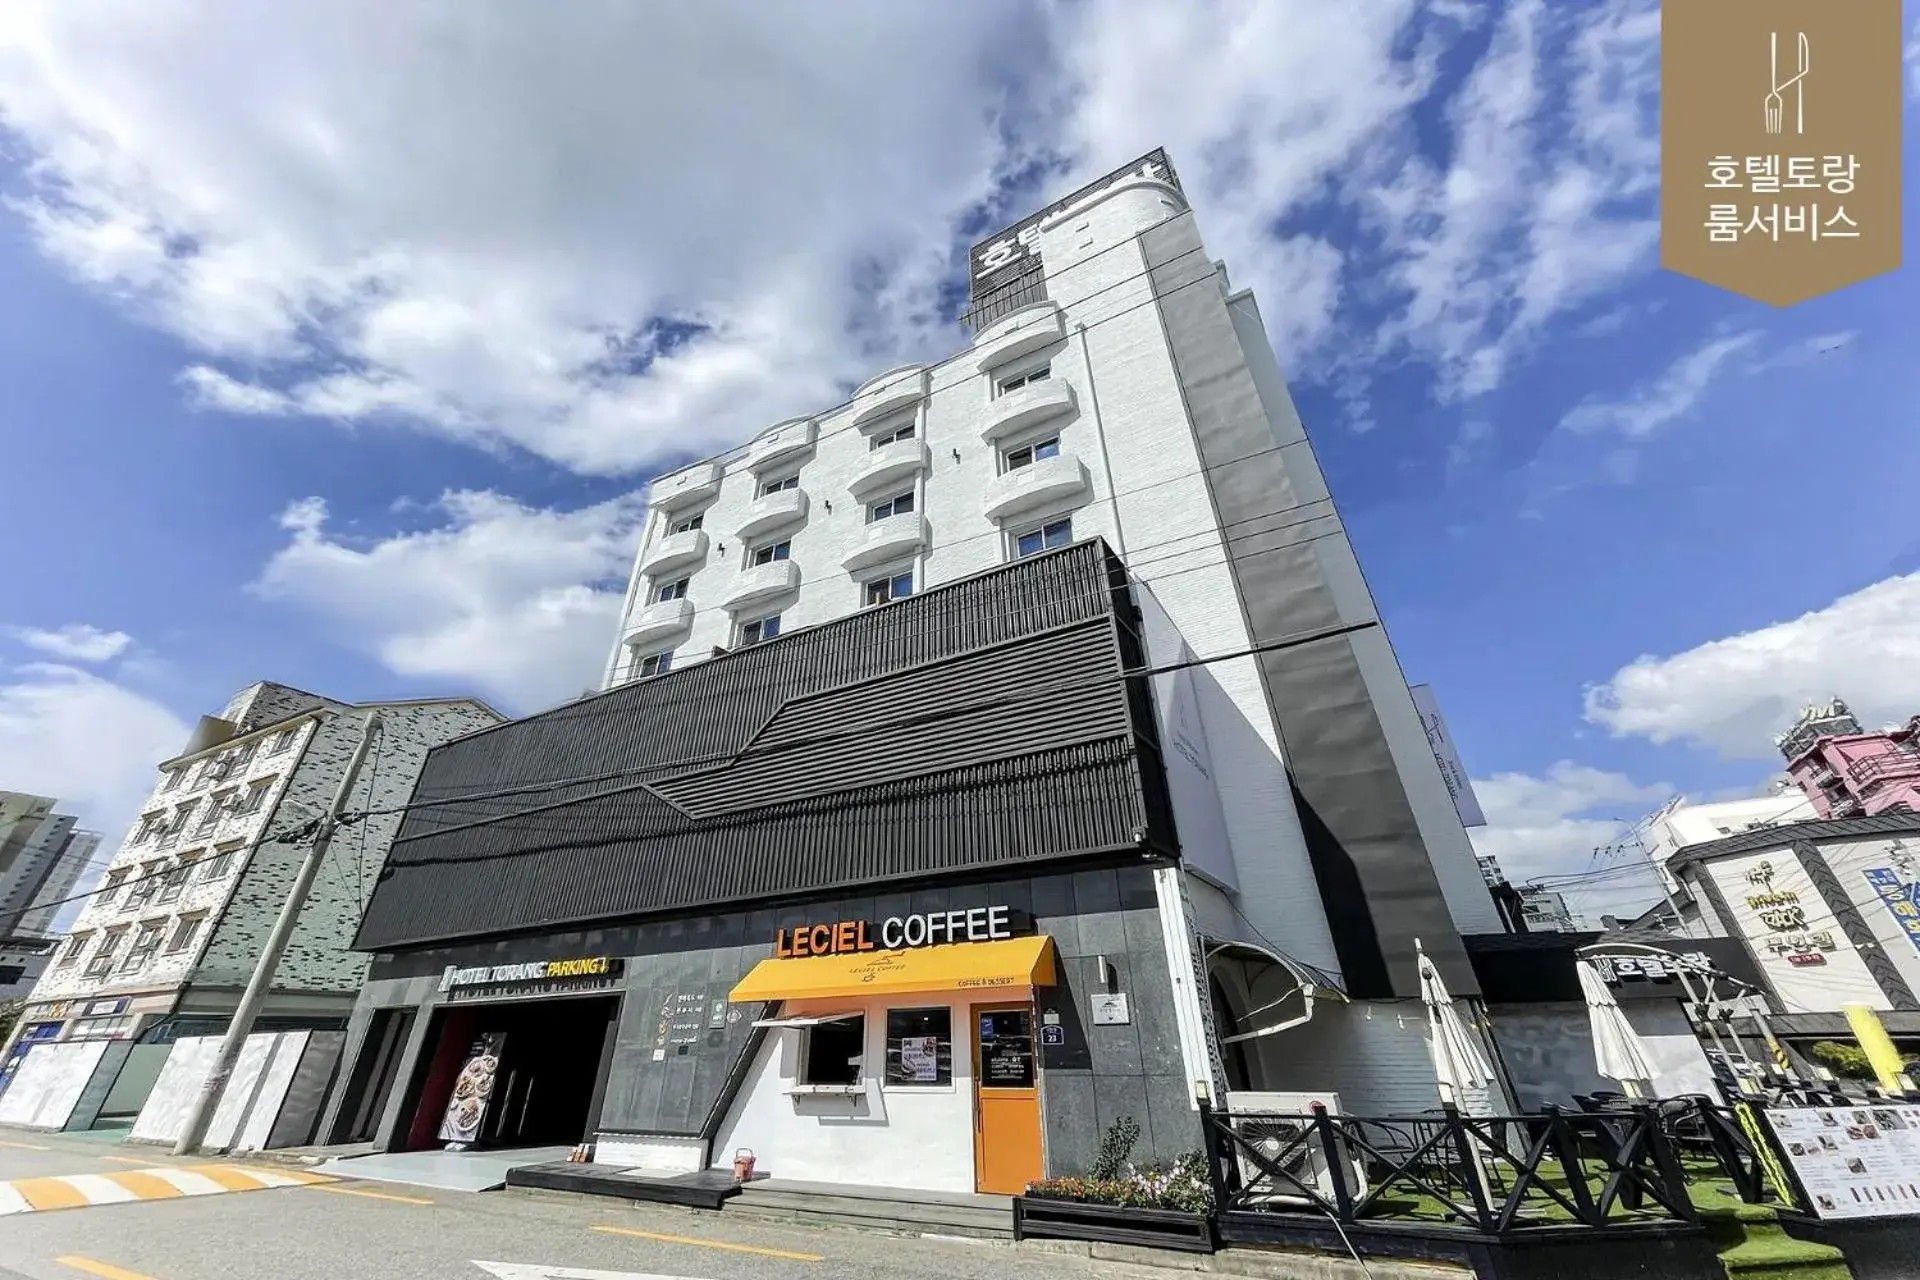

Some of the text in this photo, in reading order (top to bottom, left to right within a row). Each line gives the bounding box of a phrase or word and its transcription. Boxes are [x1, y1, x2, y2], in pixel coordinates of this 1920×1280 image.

[776, 905, 1011, 957] LECIEL COFFEE
[449, 958, 599, 985] HOTEL TORANG PARKING
[958, 979, 980, 987] COFFEE
